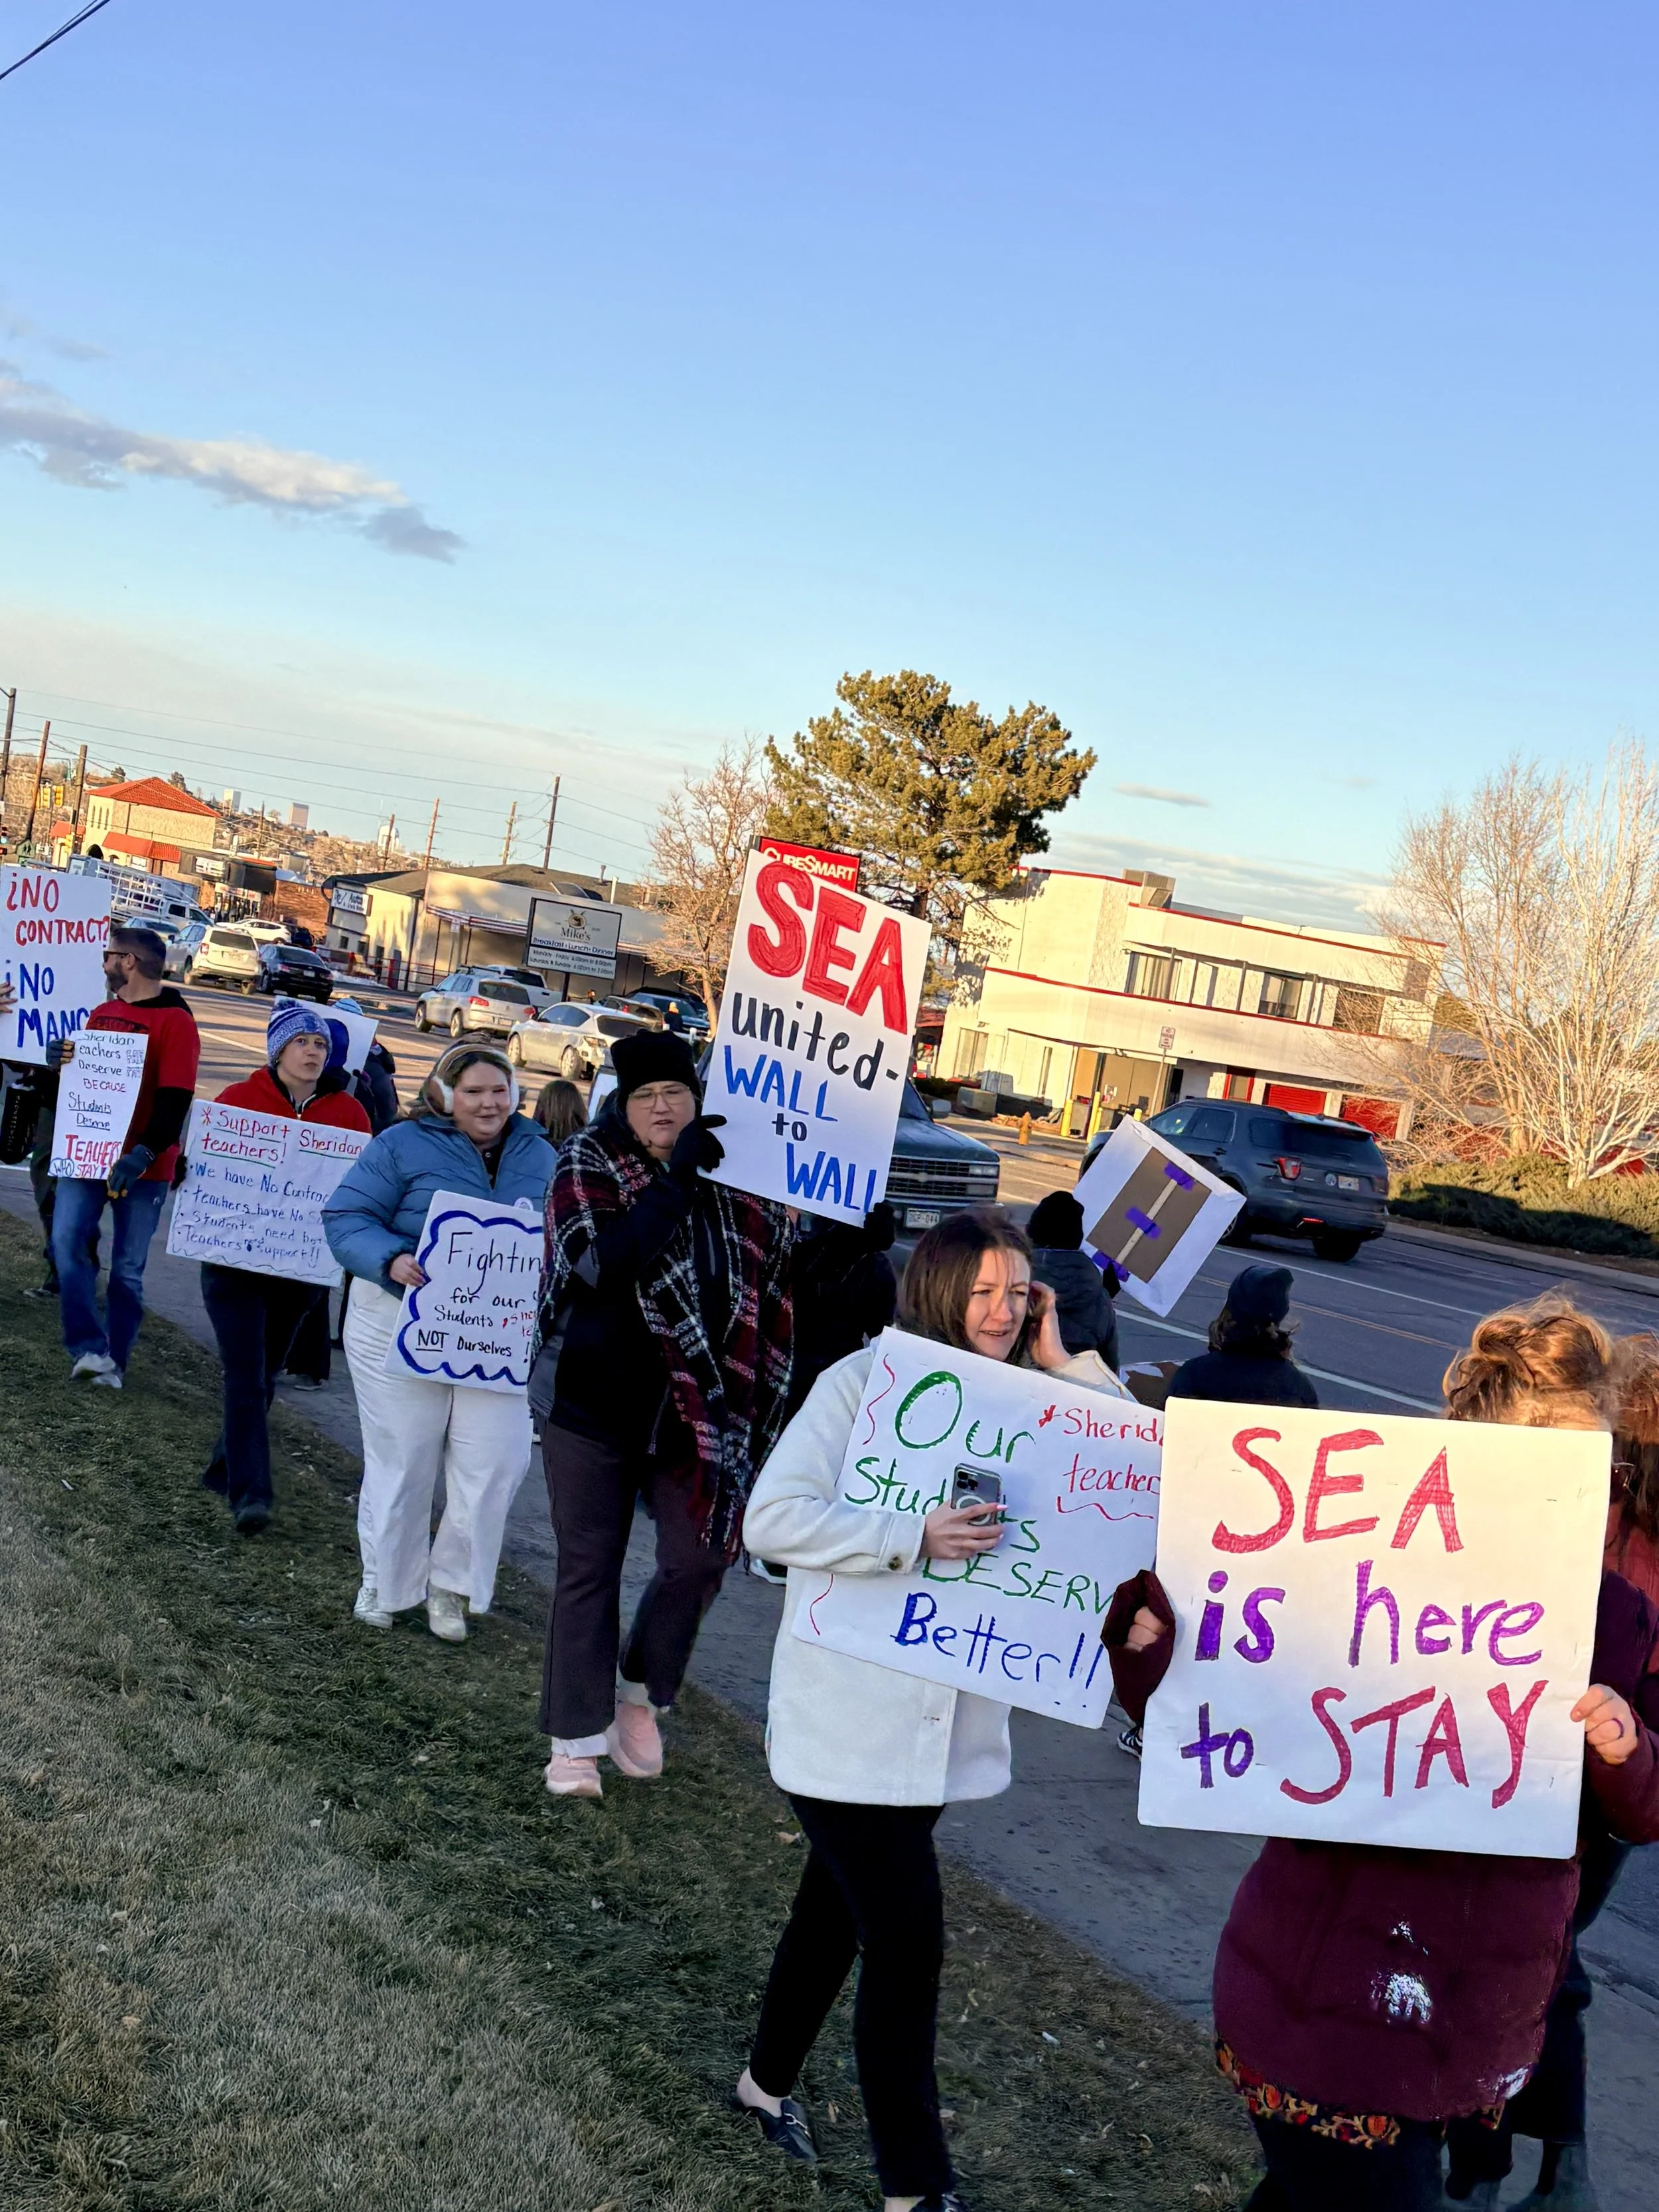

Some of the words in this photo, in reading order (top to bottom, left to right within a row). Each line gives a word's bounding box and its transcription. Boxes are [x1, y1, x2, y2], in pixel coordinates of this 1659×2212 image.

[6, 873, 59, 913] ¿NO
[16, 915, 110, 948] CONTRACT?
[532, 937, 564, 948] Breakfast
[592, 946, 614, 956] Dinner
[561, 927, 591, 940] Mike's
[747, 861, 907, 1035] SEA
[80, 1043, 121, 1059] eachers
[723, 1045, 837, 1122] WALL
[772, 1112, 807, 1142] to
[202, 1132, 286, 1163] teachers!
[195, 1162, 216, 1177] We
[226, 1168, 254, 1187] have
[448, 1232, 542, 1295] Fightin
[435, 1305, 494, 1327] Students
[451, 1288, 480, 1304] for
[492, 1295, 526, 1309] our
[417, 1329, 450, 1349] NOT
[895, 1370, 1036, 1463] Our
[1063, 1407, 1163, 1447] Sherid
[1063, 1453, 1161, 1495] teacher
[1211, 1427, 1464, 1554] SEA
[844, 1456, 1041, 1553] Studts
[922, 1552, 1116, 1615] DESERV
[1194, 1570, 1286, 1664] is
[1348, 1560, 1545, 1668] here
[891, 1592, 1104, 1709] Better!!
[1181, 1702, 1254, 1789] to
[1280, 1680, 1550, 1810] STAY
